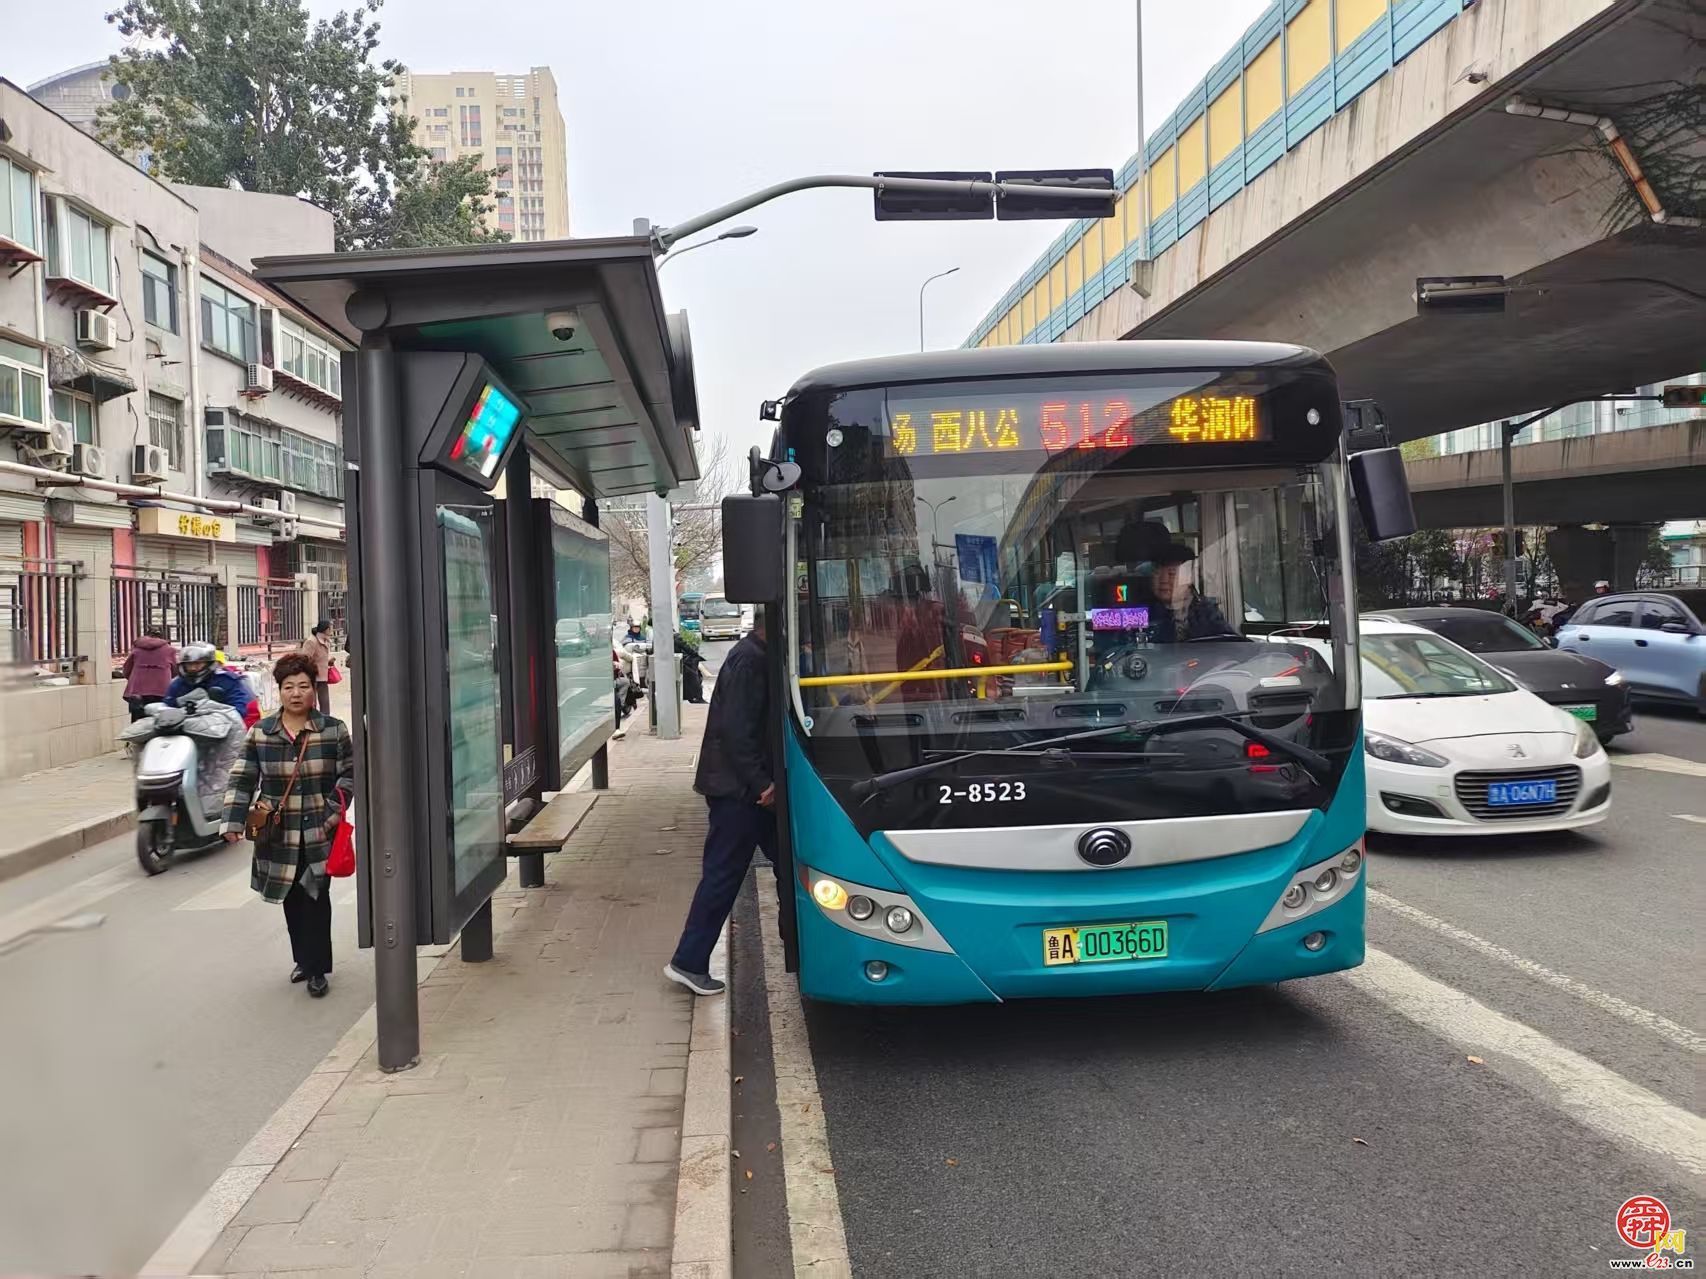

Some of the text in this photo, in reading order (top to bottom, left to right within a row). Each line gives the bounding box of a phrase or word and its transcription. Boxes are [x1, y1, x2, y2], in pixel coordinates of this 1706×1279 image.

[931, 409, 1019, 452] 西八公
[1042, 401, 1129, 450] 512
[939, 781, 1027, 804] 2-8523
[1085, 927, 1165, 957] 00366D
